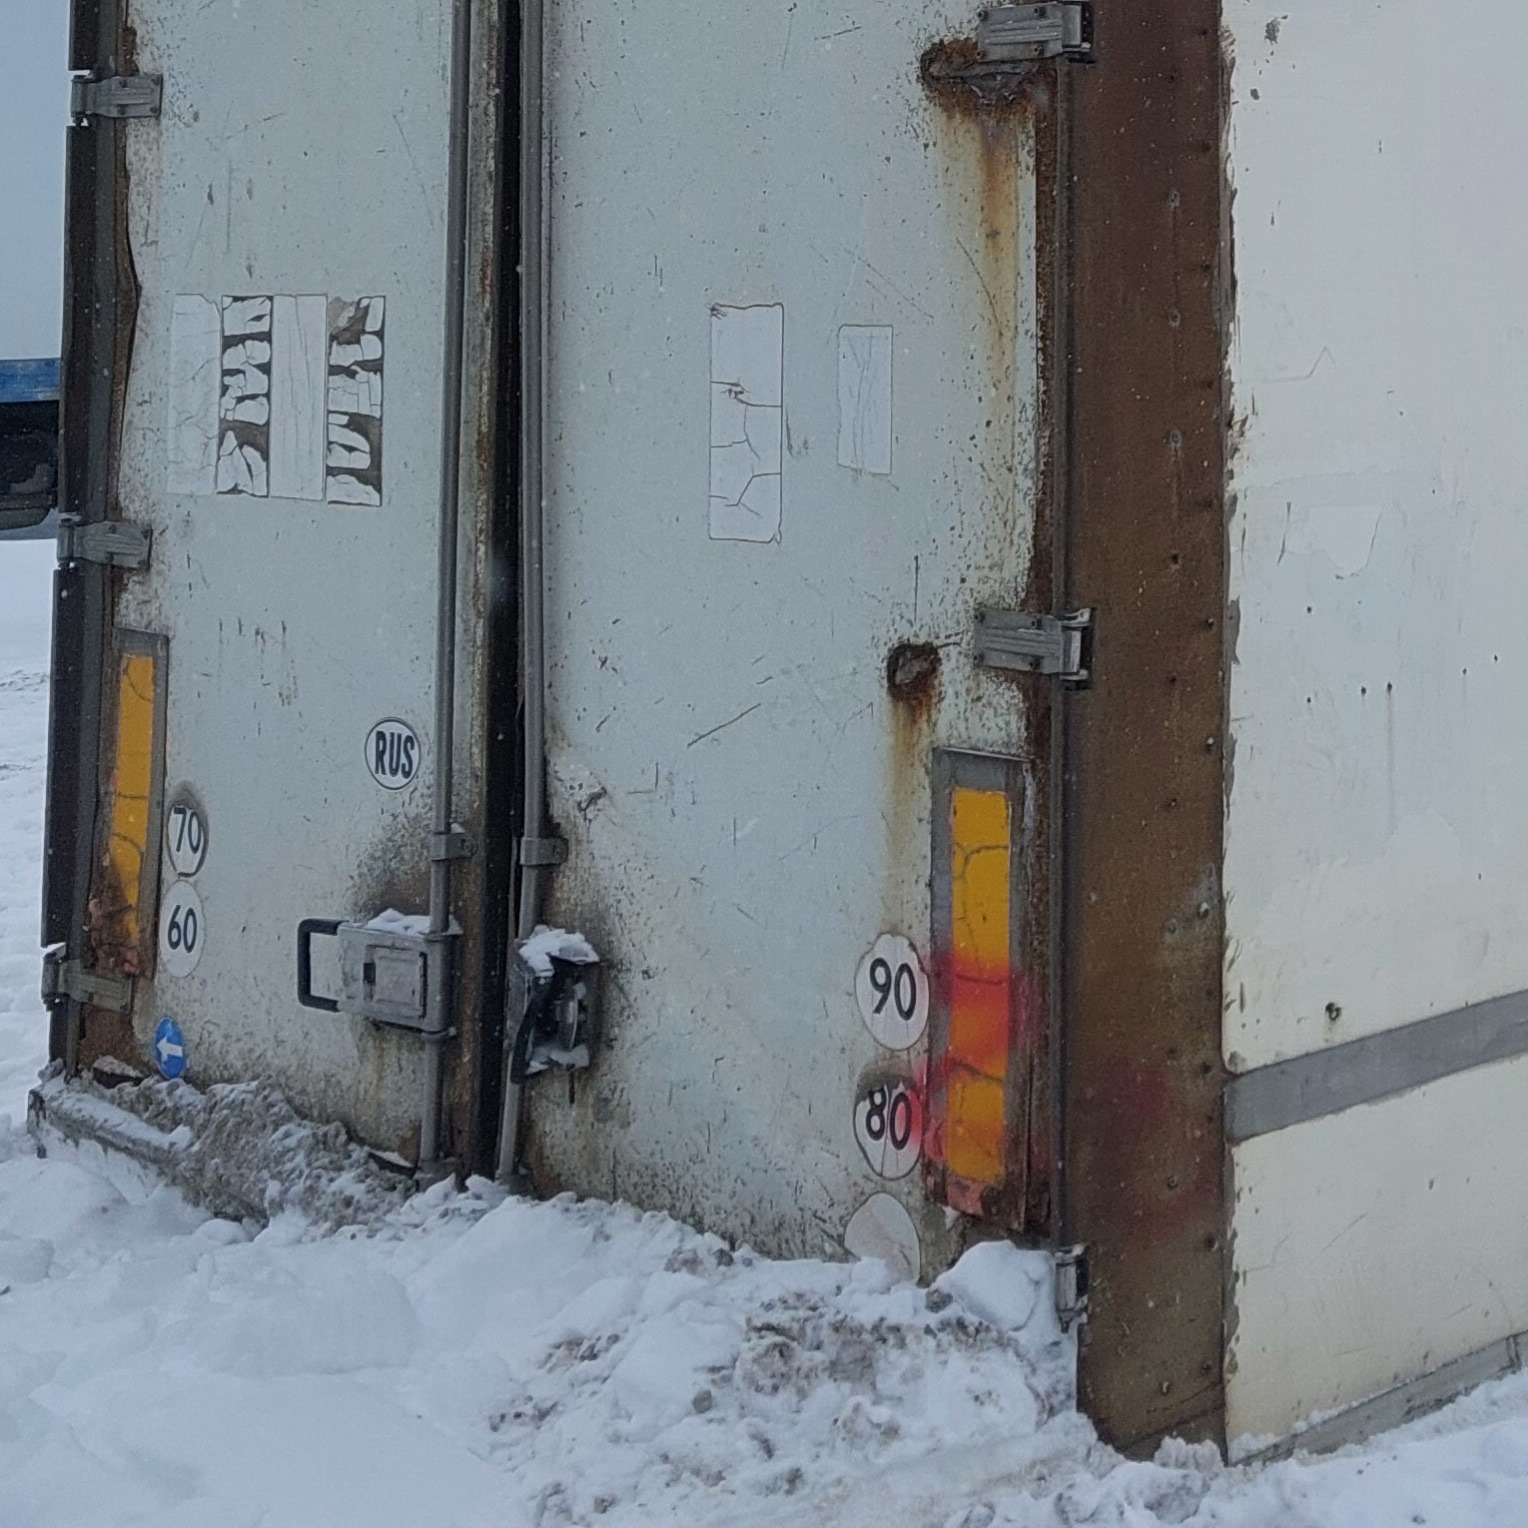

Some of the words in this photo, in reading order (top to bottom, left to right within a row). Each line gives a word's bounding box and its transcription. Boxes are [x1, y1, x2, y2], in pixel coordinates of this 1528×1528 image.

[374, 730, 416, 780] RUS
[173, 805, 203, 855] 70
[167, 904, 198, 954] 60
[868, 956, 917, 1022] 90
[864, 1084, 913, 1151] 80
